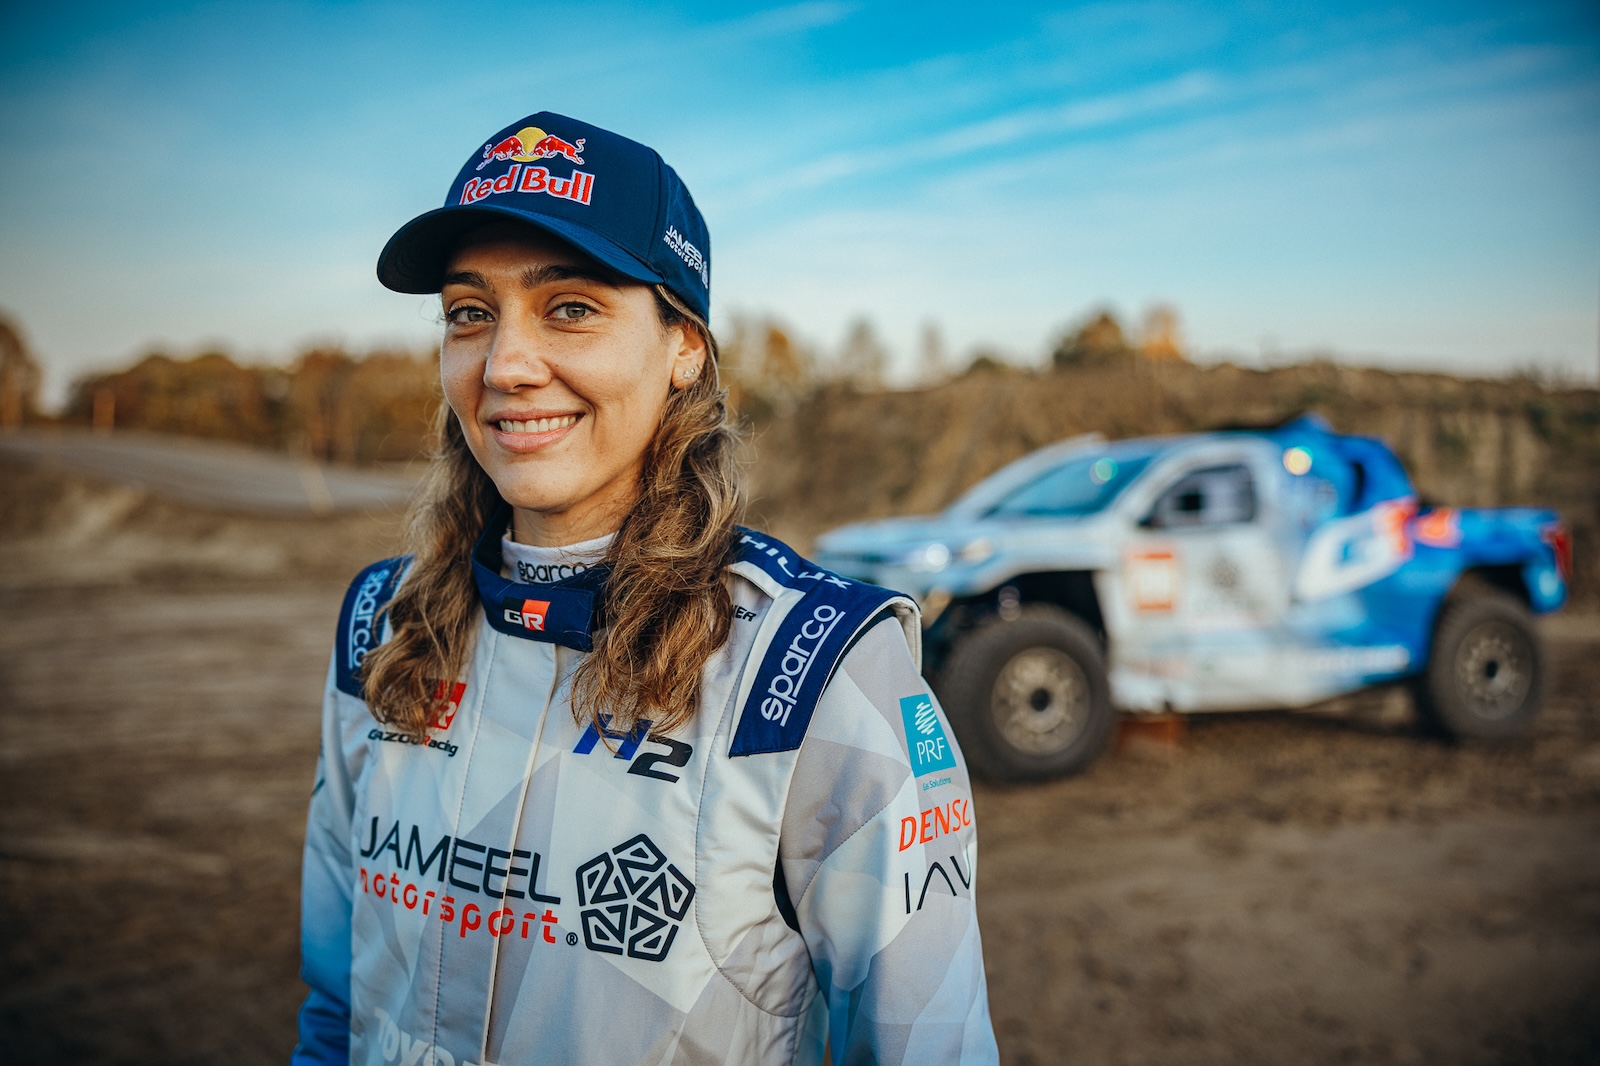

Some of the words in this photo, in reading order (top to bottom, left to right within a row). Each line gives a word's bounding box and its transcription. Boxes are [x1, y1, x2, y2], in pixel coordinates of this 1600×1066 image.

[459, 164, 521, 205] Red
[518, 165, 595, 206] Bull
[739, 534, 853, 590] HILUX
[503, 608, 544, 632] GR
[760, 604, 846, 727] sparco
[572, 713, 693, 784] H2
[916, 736, 946, 766] PRF
[360, 816, 562, 905] JAMEEL
